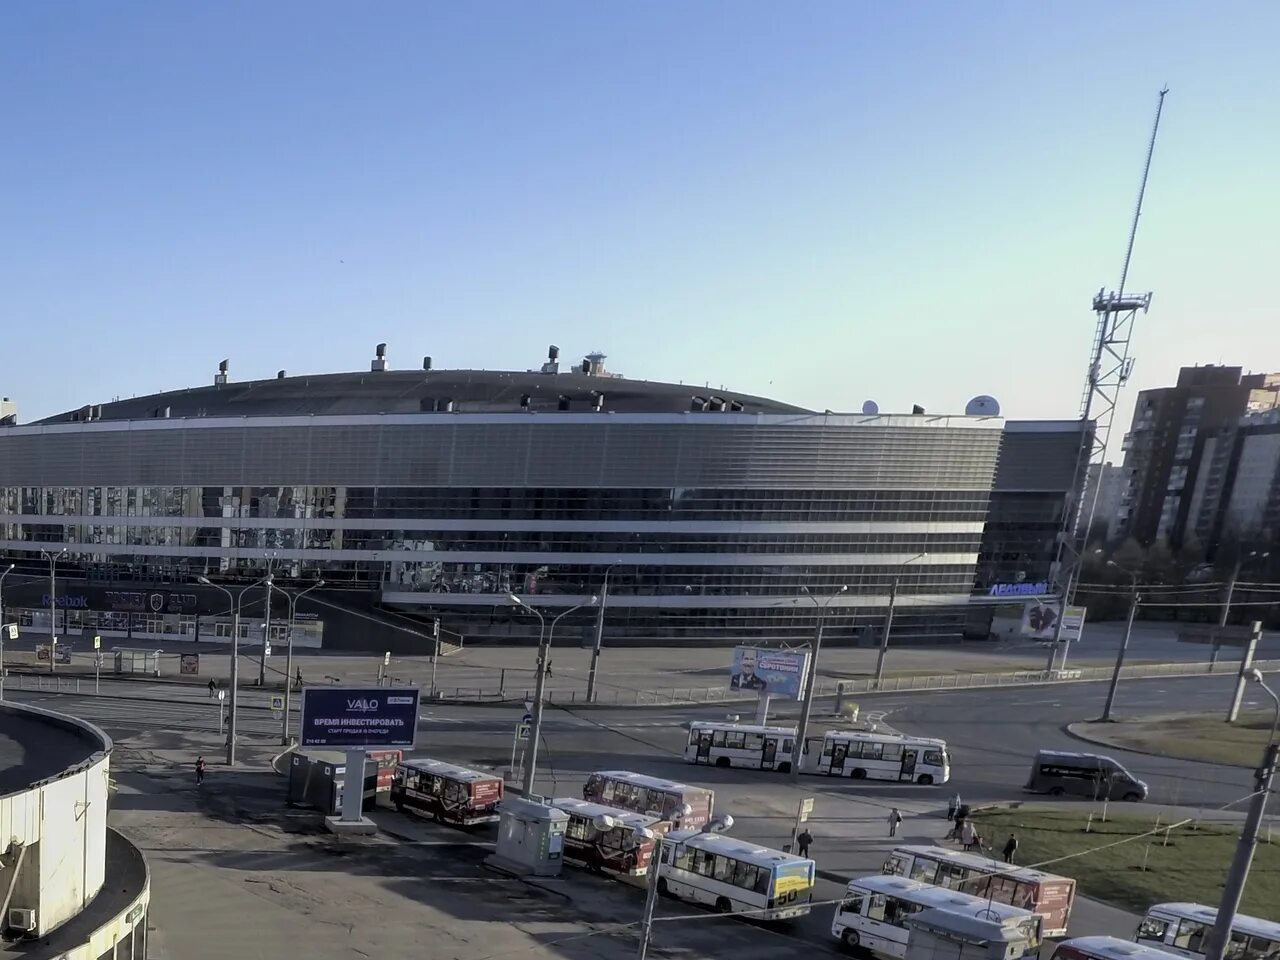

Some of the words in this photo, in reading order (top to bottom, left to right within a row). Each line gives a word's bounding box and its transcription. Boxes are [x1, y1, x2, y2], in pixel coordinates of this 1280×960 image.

[41, 594, 89, 608] Reebok
[347, 699, 379, 709] VALO
[314, 718, 340, 726] ВРЕМЯ
[340, 718, 404, 726] ИНВЕСТИРОВАТЬ
[778, 888, 798, 905] 50
